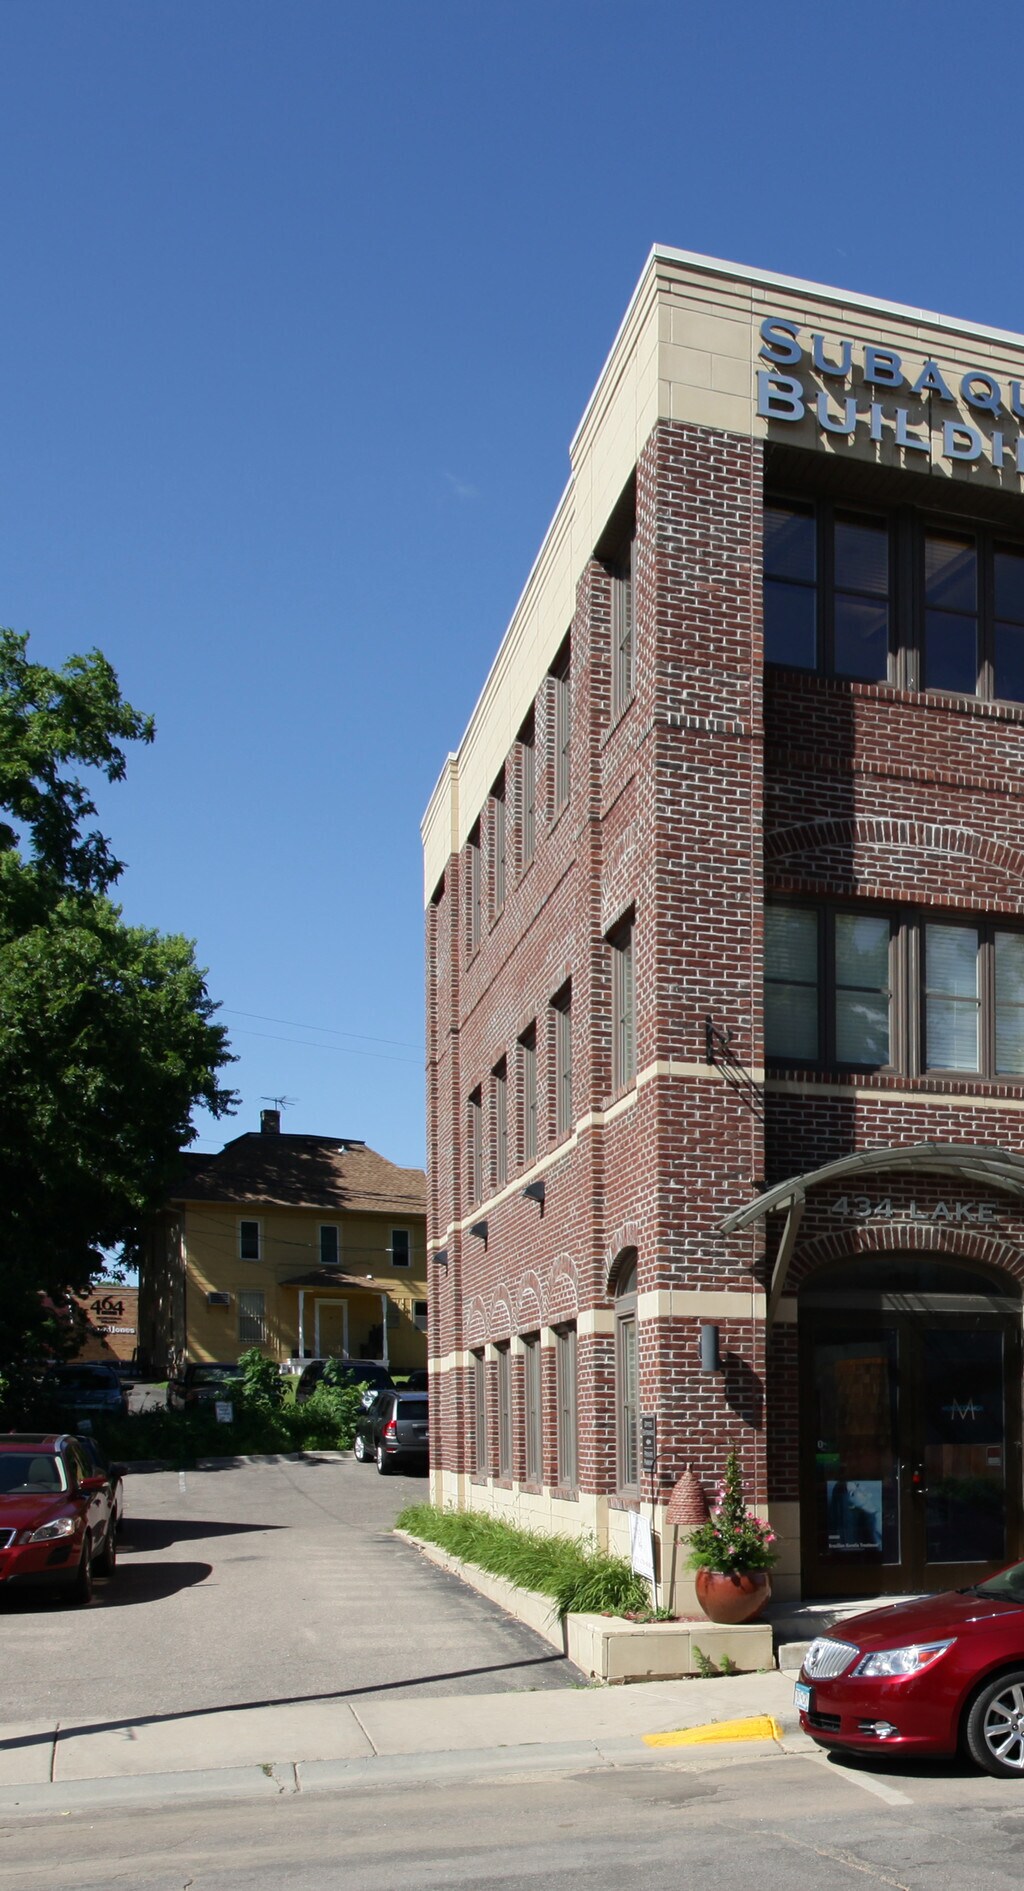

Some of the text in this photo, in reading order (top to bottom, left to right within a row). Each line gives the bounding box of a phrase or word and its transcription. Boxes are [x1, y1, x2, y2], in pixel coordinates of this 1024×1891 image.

[831, 1196, 996, 1222] 434 LAKE
[90, 1295, 125, 1316] 464
